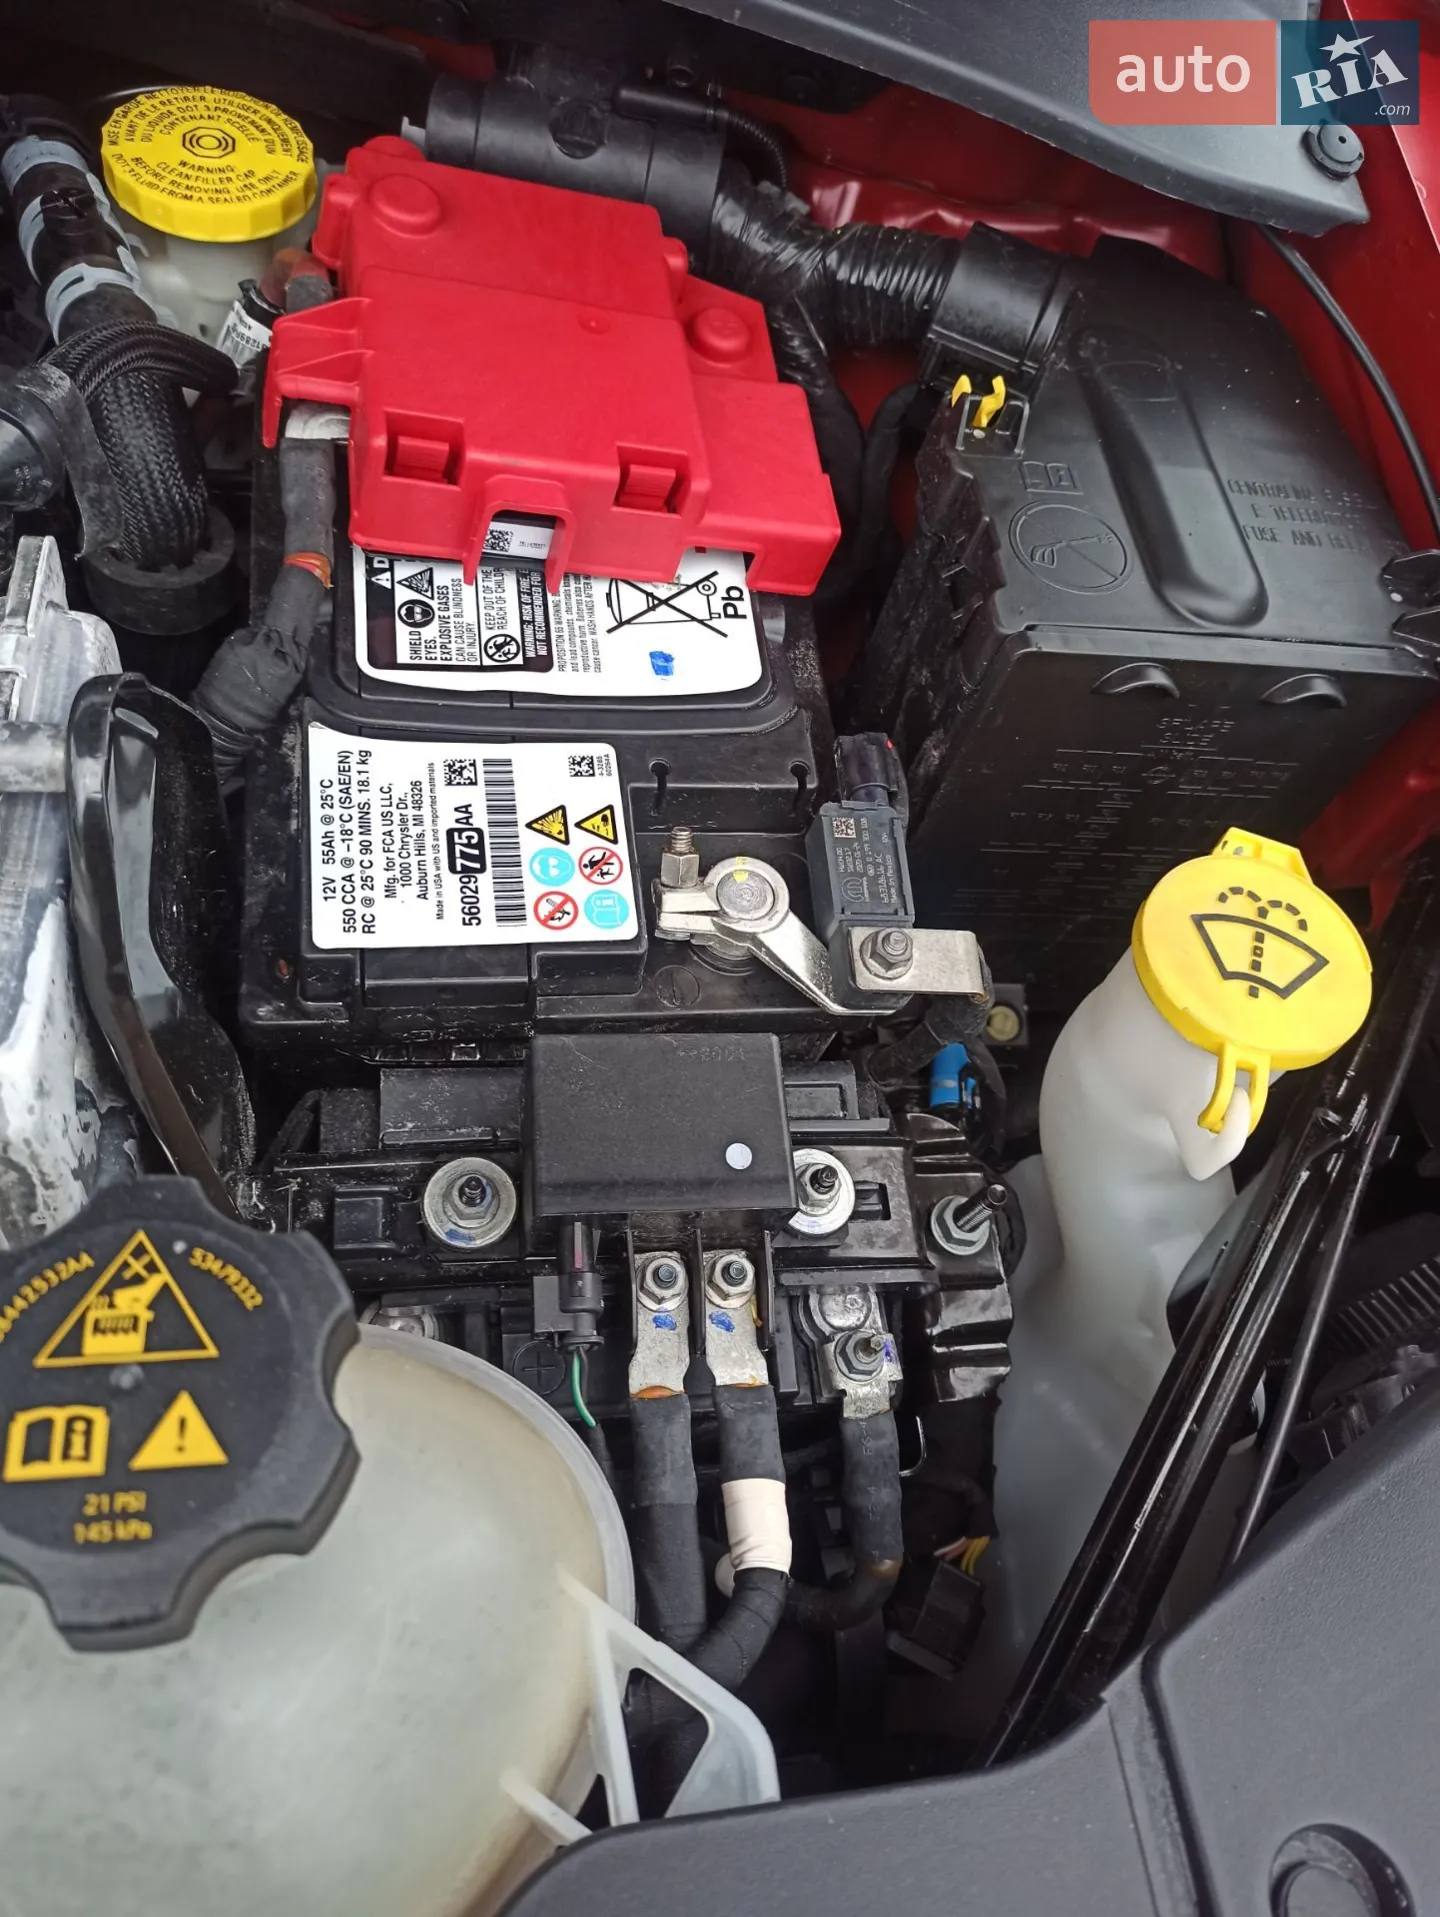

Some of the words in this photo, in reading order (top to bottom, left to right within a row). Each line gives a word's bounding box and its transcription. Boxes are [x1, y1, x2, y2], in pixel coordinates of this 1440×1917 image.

[156, 161, 193, 181] CLEAN
[481, 569, 492, 582] THE
[436, 585, 450, 612] GASES
[451, 578, 464, 619] BLINDNESS
[483, 585, 493, 594] OF
[495, 596, 506, 604] OF
[521, 593, 531, 603] OF
[583, 581, 594, 599] AFTER
[483, 596, 494, 610] OUT
[522, 605, 532, 621] RISK
[532, 587, 546, 639] RECOMMENDED
[584, 600, 596, 618] HANDS
[721, 586, 747, 619] Pb
[485, 613, 495, 630] KEEP
[496, 606, 507, 630] REACH
[588, 620, 597, 635] WASH
[438, 614, 452, 661] EXPLOSIVE
[454, 621, 465, 643] CAUSE
[465, 621, 476, 650] INJURY.
[523, 622, 536, 657] WARNING:
[409, 631, 422, 660] SHIELD
[424, 636, 437, 660] EYES.
[455, 644, 466, 662] CAN
[537, 641, 547, 655] NOT
[555, 635, 567, 671] PROPOSITION
[569, 650, 578, 660] lead
[467, 653, 477, 662] OR
[570, 662, 579, 672] and
[593, 657, 601, 673] cause
[356, 750, 372, 765] kg
[338, 750, 355, 809] (SAE/EN)
[357, 768, 370, 792] 18.1
[427, 763, 436, 795] materials
[320, 778, 334, 809] 25°C
[380, 783, 394, 807] LLC,
[396, 792, 408, 809] Dr.,
[410, 780, 423, 811] 48326
[321, 814, 335, 825] @
[358, 798, 372, 836] MINS.
[381, 809, 394, 827] US
[412, 815, 424, 827] MI
[429, 797, 438, 828] imported
[382, 829, 395, 853] FCA
[398, 811, 413, 859] Chrysler
[413, 829, 426, 856] Hills,
[431, 829, 439, 843] and
[321, 830, 335, 865] 55Ah
[359, 839, 373, 855] 90
[432, 845, 440, 856] US
[340, 857, 354, 868] @
[383, 856, 395, 872] for
[433, 858, 441, 873] with
[359, 859, 374, 891] 25°C
[399, 861, 412, 888] 1000
[415, 860, 428, 900] Auburn
[434, 874, 443, 892] USA
[323, 876, 336, 902] 12V
[342, 873, 356, 904] CCA
[384, 874, 399, 898] Mfg.
[361, 896, 375, 908] @
[436, 901, 444, 920] Made
[343, 908, 357, 933] 550
[361, 913, 376, 934] RC
